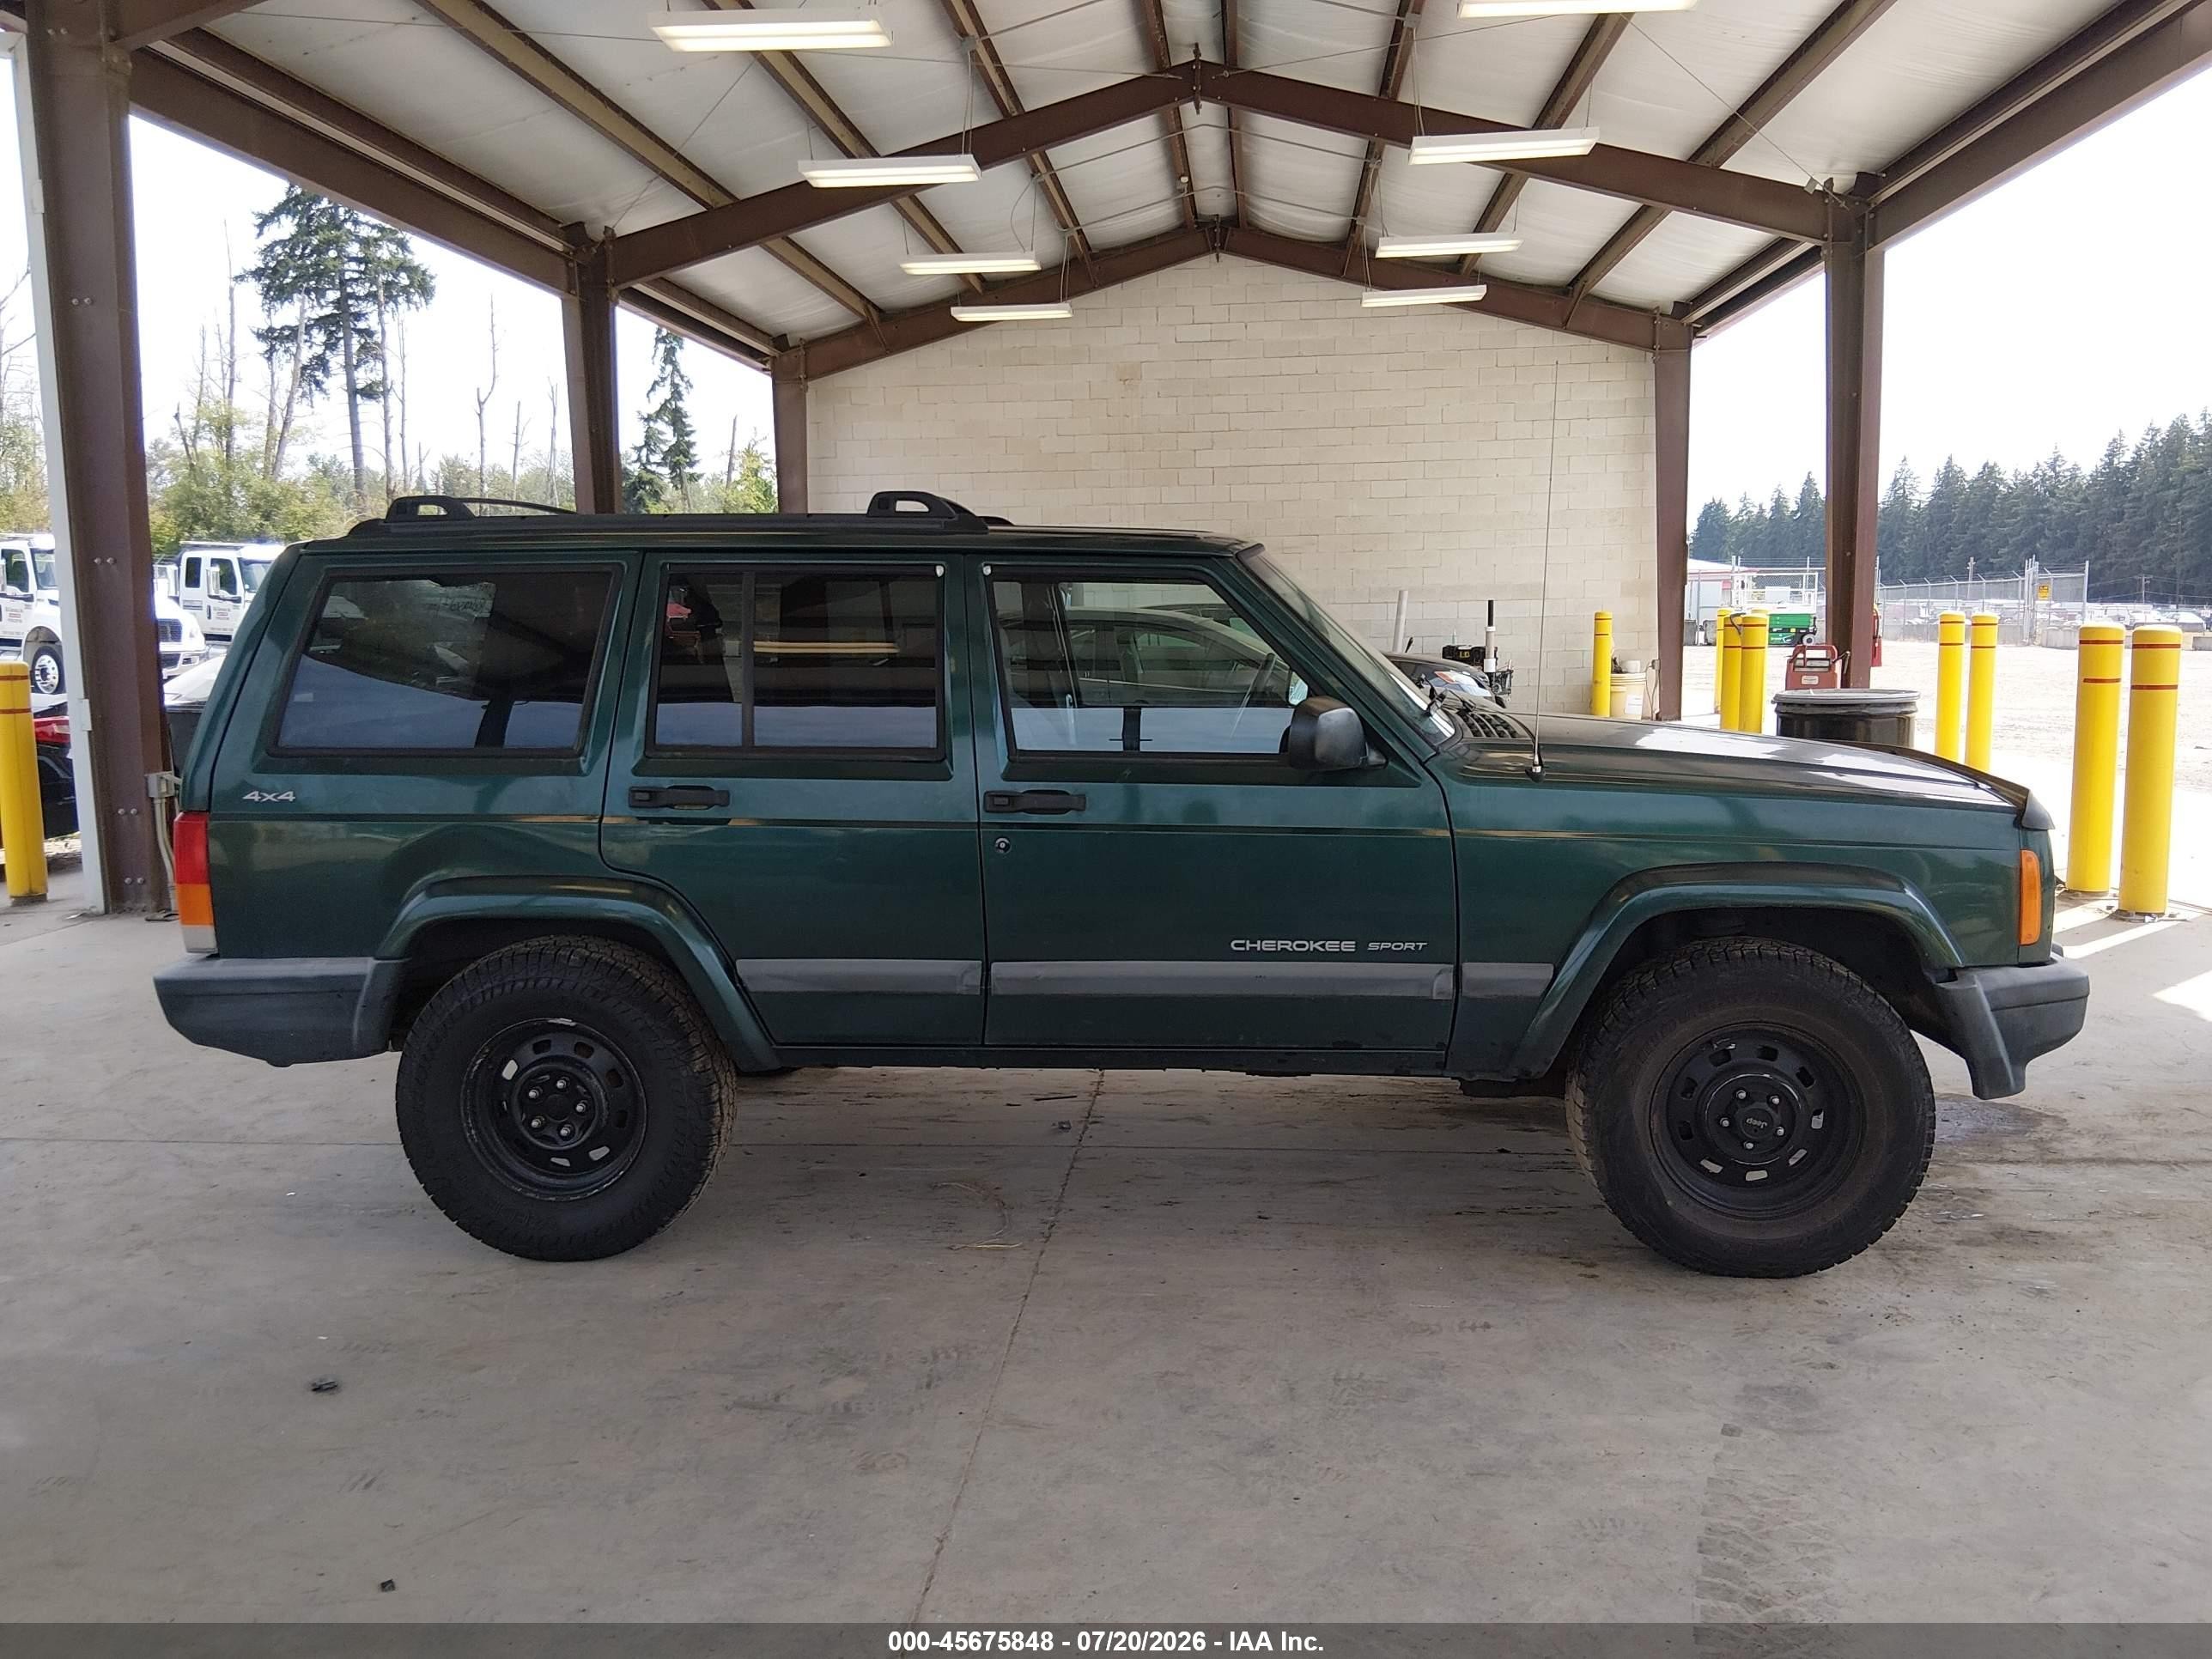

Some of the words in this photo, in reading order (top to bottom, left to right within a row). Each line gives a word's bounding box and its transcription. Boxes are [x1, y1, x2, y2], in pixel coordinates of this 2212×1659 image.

[1230, 939, 1356, 952] CHEROKEE
[1367, 941, 1427, 951] SPORT
[1746, 1117, 1768, 1129] Jeep
